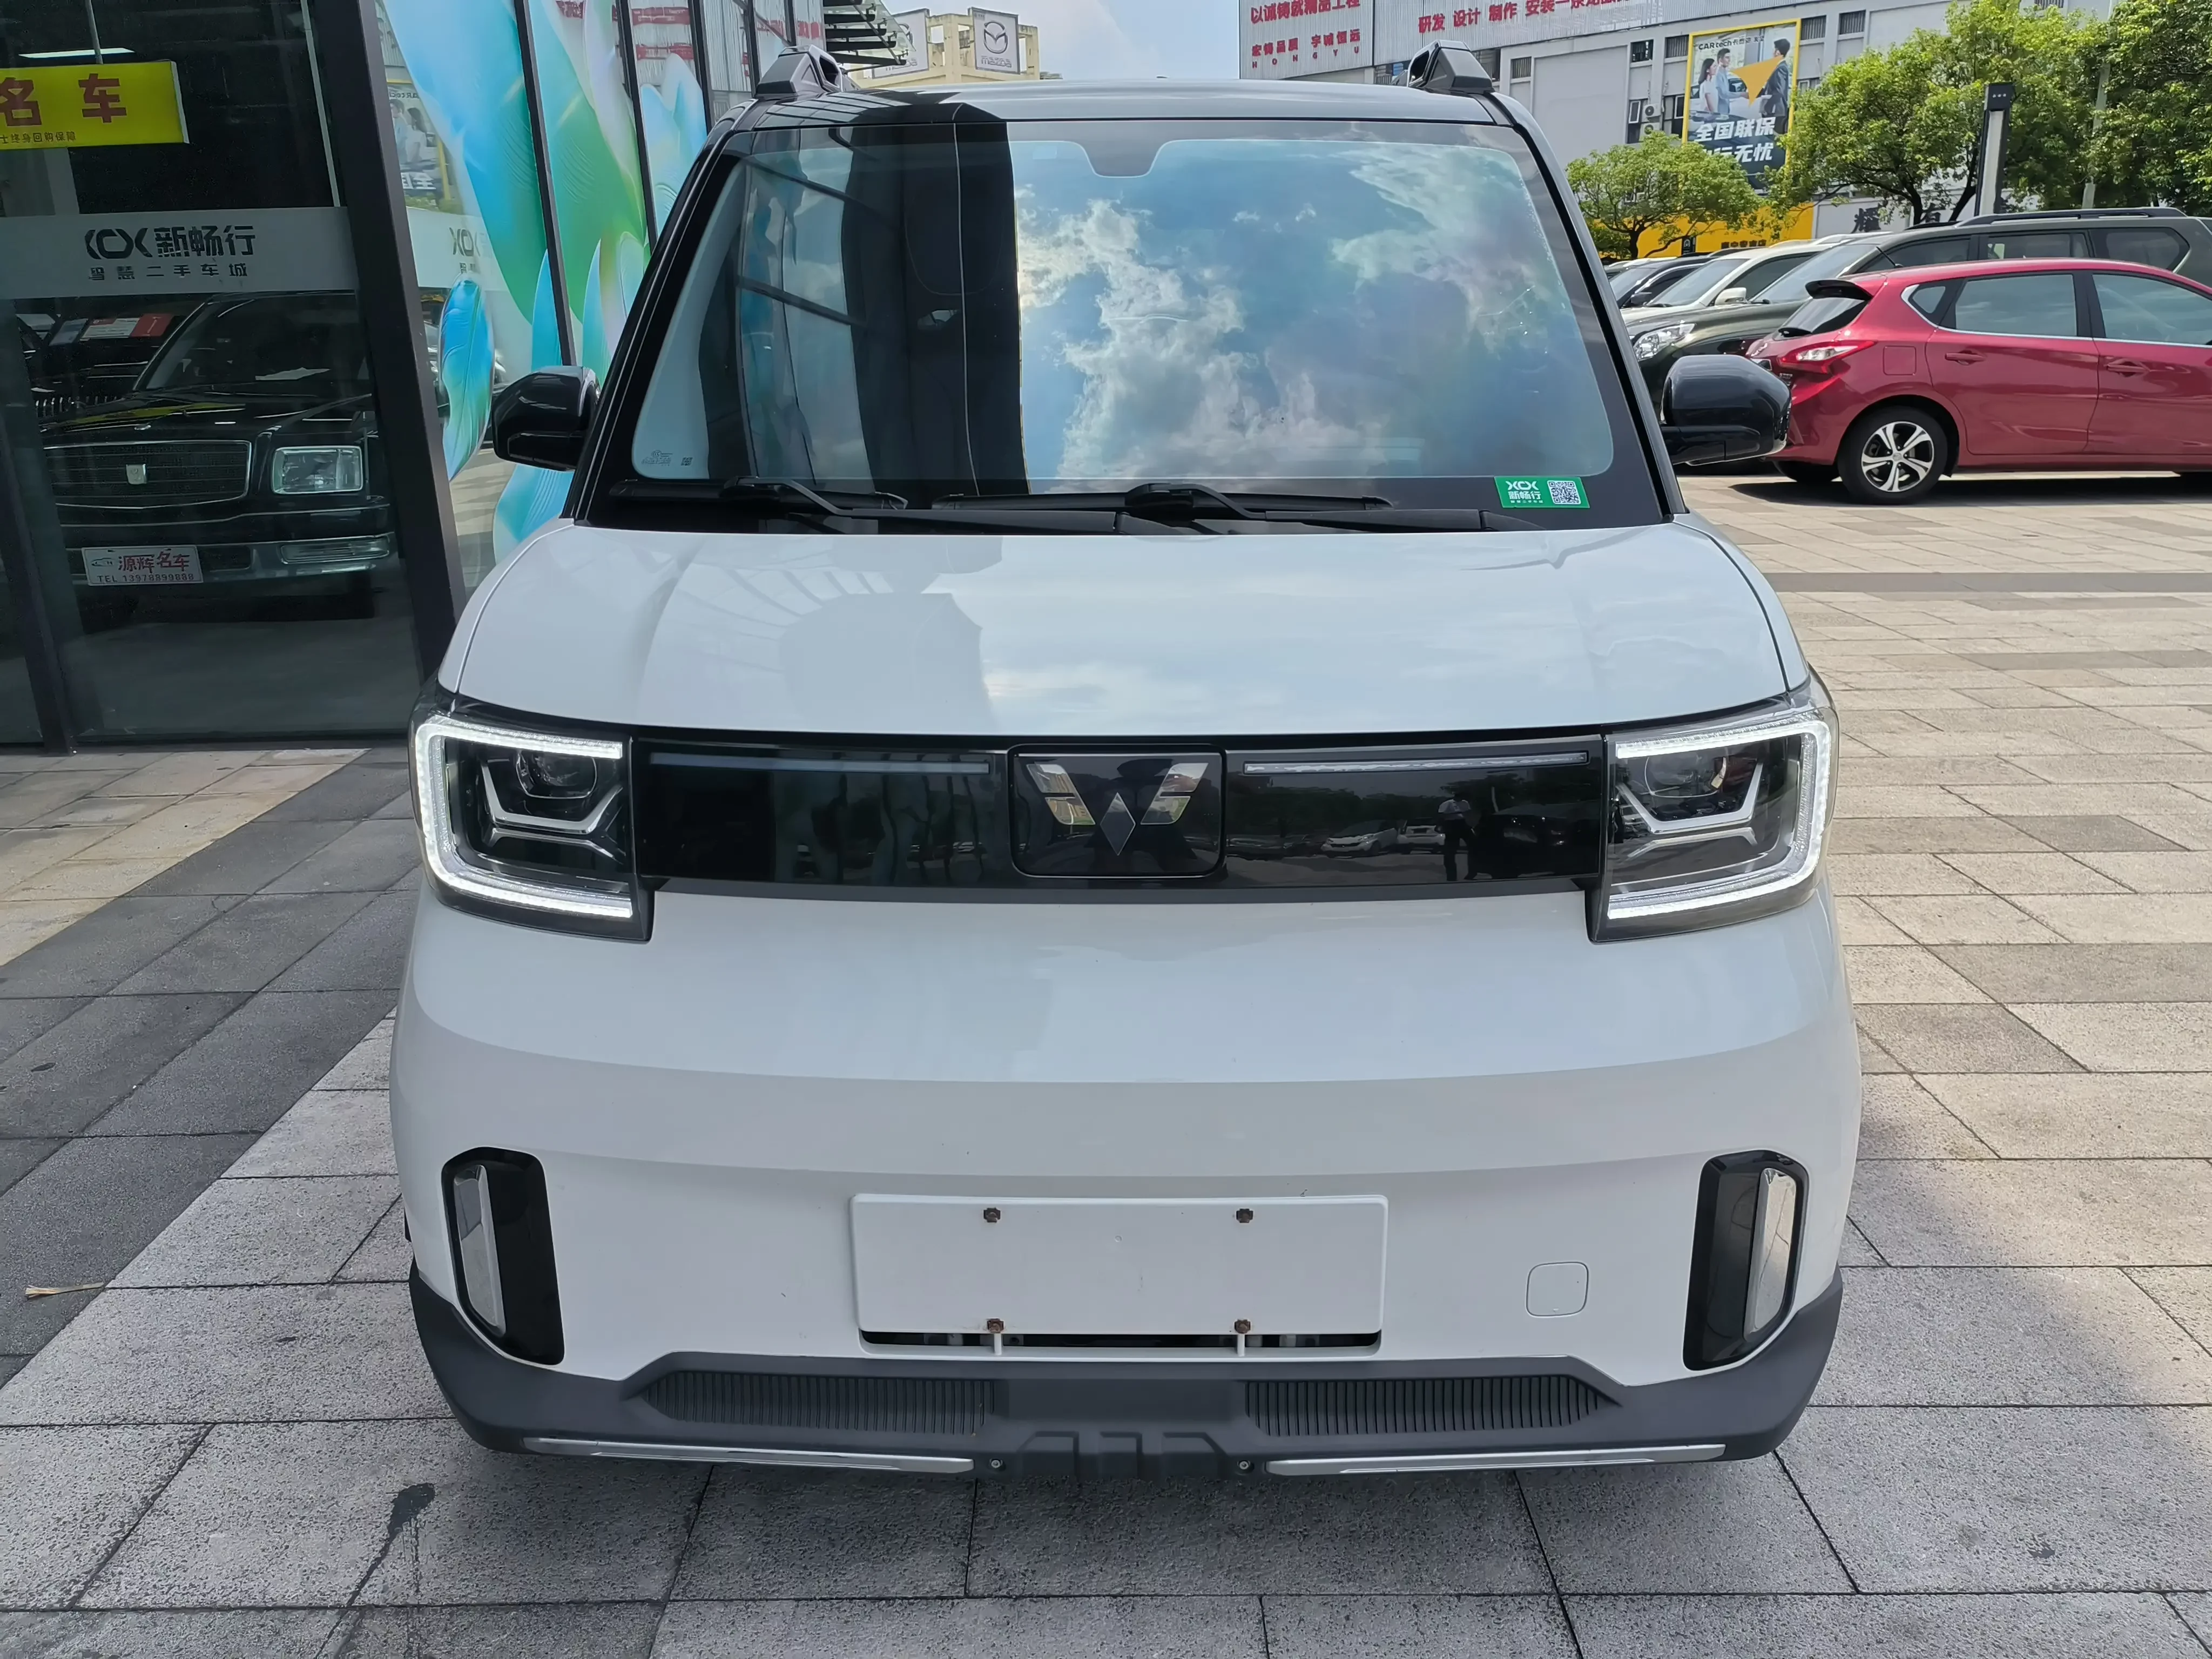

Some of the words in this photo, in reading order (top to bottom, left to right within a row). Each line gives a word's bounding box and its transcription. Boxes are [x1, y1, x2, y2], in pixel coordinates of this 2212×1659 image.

[1418, 13, 1445, 33] 研发
[1453, 7, 1481, 27] 设计
[1488, 2, 1517, 21] 制作
[0, 73, 127, 126] 名车
[1694, 117, 1776, 142] 全国联保
[154, 225, 255, 258] 新畅行
[88, 263, 247, 280] 智慧二手车城
[1508, 491, 1541, 500] 新畅行
[118, 551, 190, 574] 源辉名车
